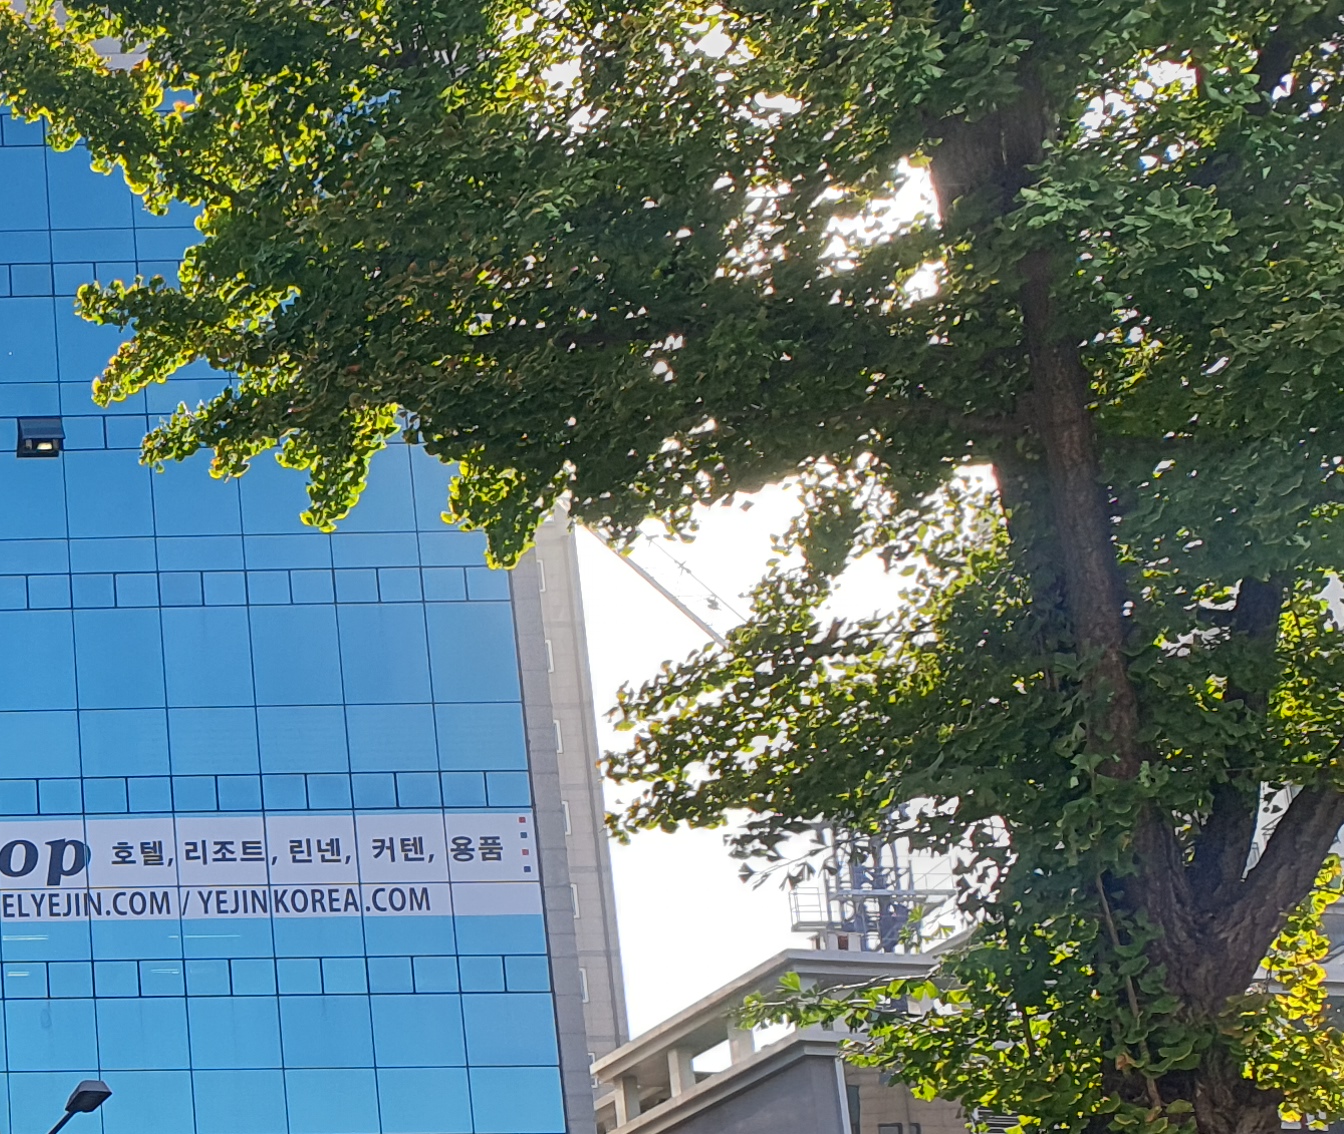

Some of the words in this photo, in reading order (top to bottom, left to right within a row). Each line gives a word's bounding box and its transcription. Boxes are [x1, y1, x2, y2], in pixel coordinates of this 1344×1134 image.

[110, 839, 175, 868] 호텔,
[183, 838, 278, 867] 리조트,
[288, 836, 352, 865] 린넨,
[449, 835, 504, 863] 용품
[197, 887, 432, 915] YEJINKOREA.COM
